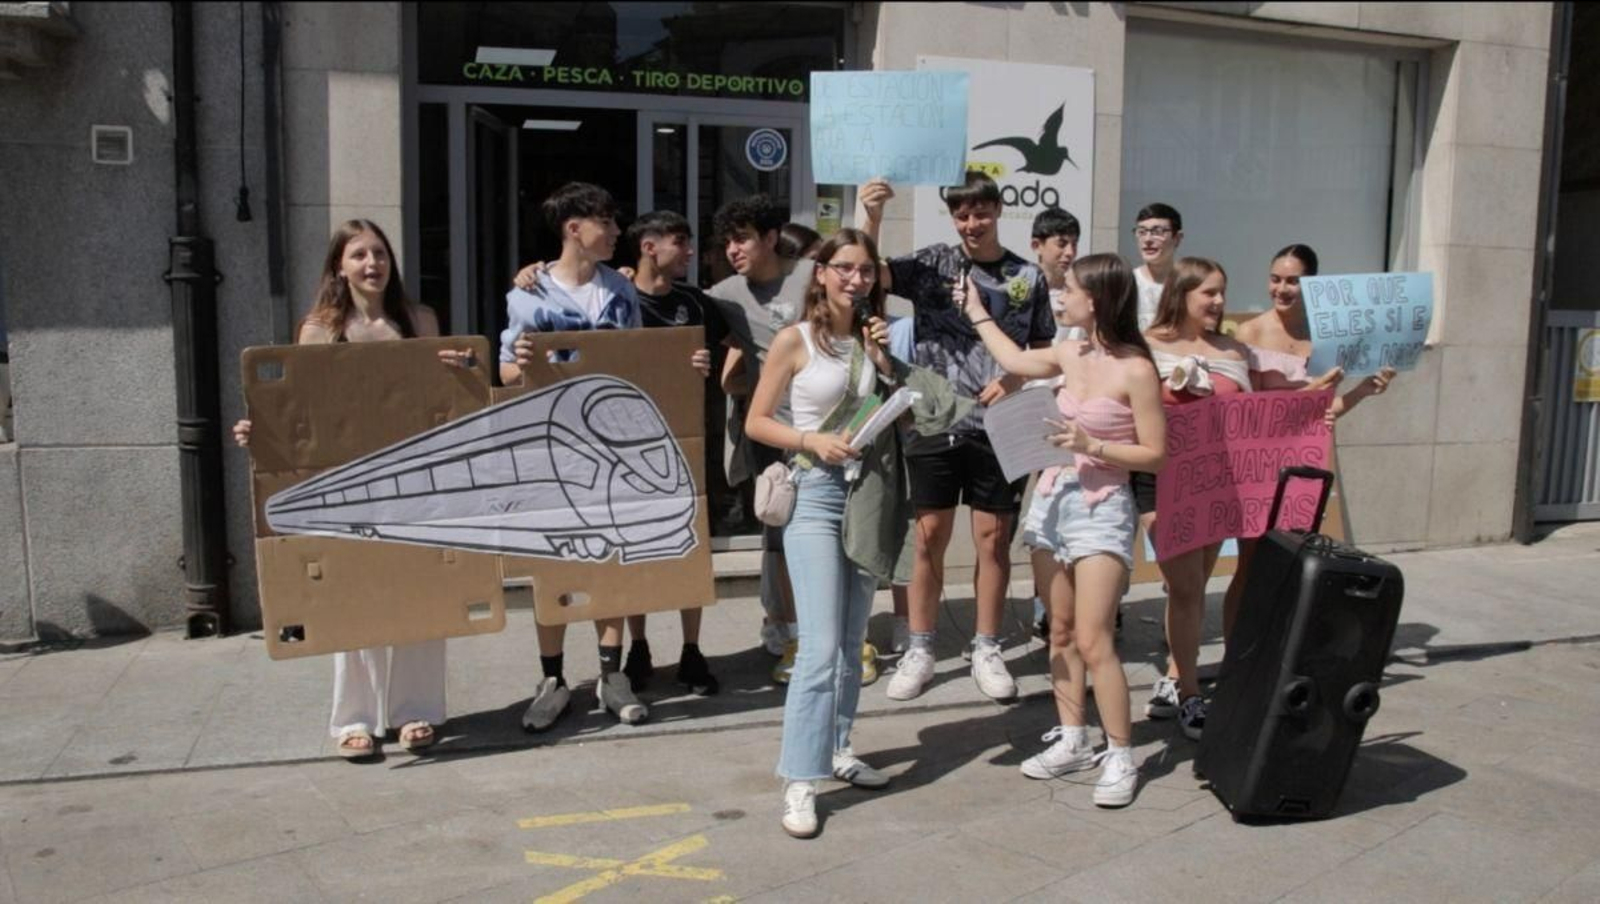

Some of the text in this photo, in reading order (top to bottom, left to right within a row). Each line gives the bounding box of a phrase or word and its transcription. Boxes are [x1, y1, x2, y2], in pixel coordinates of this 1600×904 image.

[463, 62, 803, 95] CAZA PESCA TIRO DEPORTIVO
[1308, 275, 1408, 308] POR QUE
[1313, 309, 1376, 339] ELES
[1412, 305, 1427, 331] E
[1166, 408, 1201, 457] SE
[1206, 398, 1266, 443] NON
[1173, 445, 1324, 503] PECHAMOS
[1164, 506, 1196, 551] AS
